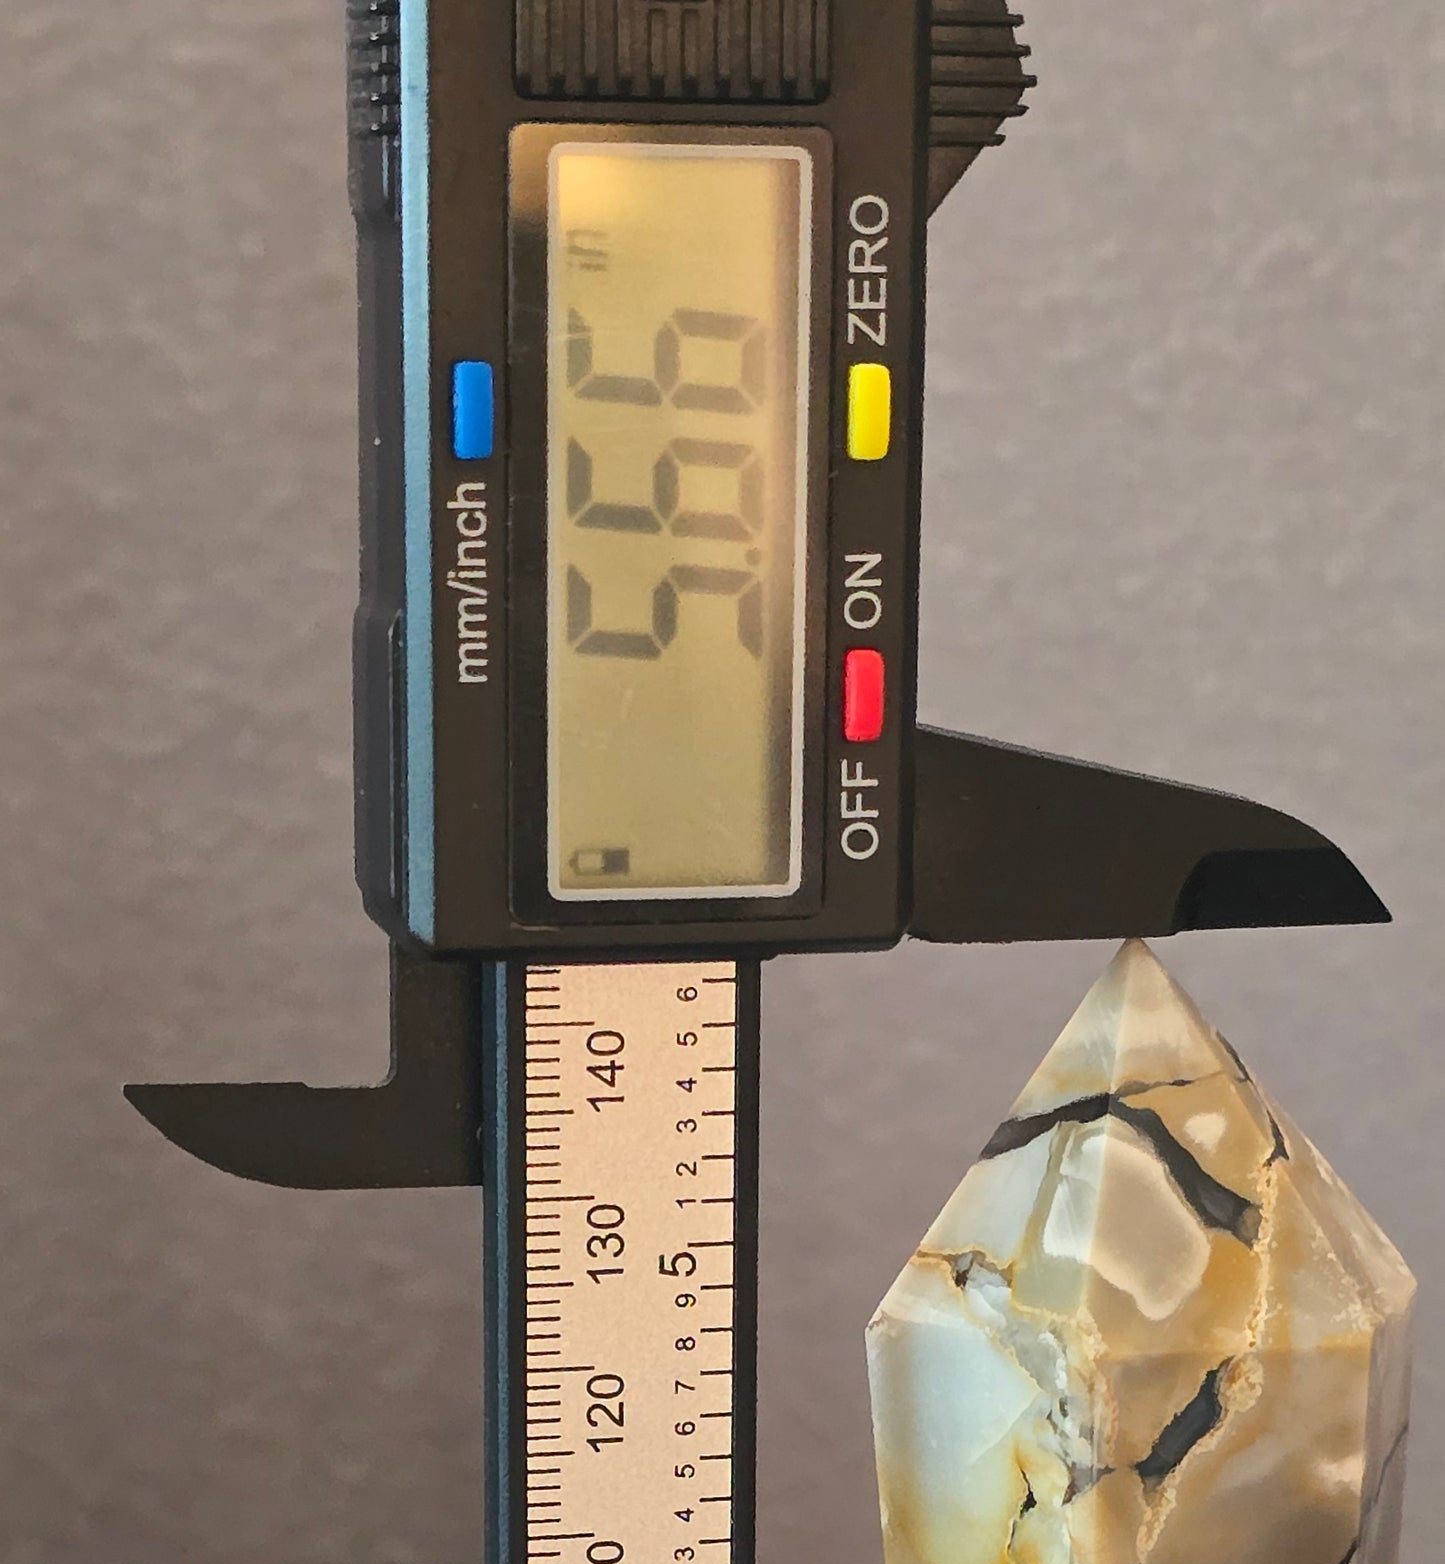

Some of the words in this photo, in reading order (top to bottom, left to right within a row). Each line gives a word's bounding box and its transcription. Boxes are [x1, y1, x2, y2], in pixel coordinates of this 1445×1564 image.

[848, 194, 890, 346] ZERO
[566, 306, 767, 661] 5.66
[447, 482, 489, 685] mm/inch
[844, 553, 882, 629] ON
[840, 759, 880, 860] OFF
[675, 986, 699, 1003] 6
[675, 1031, 699, 1047] 5
[586, 1029, 626, 1113] 140
[675, 1076, 698, 1094] 4
[675, 1117, 698, 1134] 3
[675, 1160, 698, 1177] 2
[674, 1198, 698, 1210] 1
[586, 1203, 626, 1285] 130
[658, 1251, 697, 1278] 5
[674, 1292, 697, 1309] 9
[674, 1335, 697, 1352] 8
[674, 1379, 696, 1395] 7
[586, 1373, 625, 1454] 120
[673, 1420, 696, 1437] 6
[673, 1463, 696, 1479] 5
[673, 1507, 695, 1523] 4
[673, 1546, 696, 1562] 3
